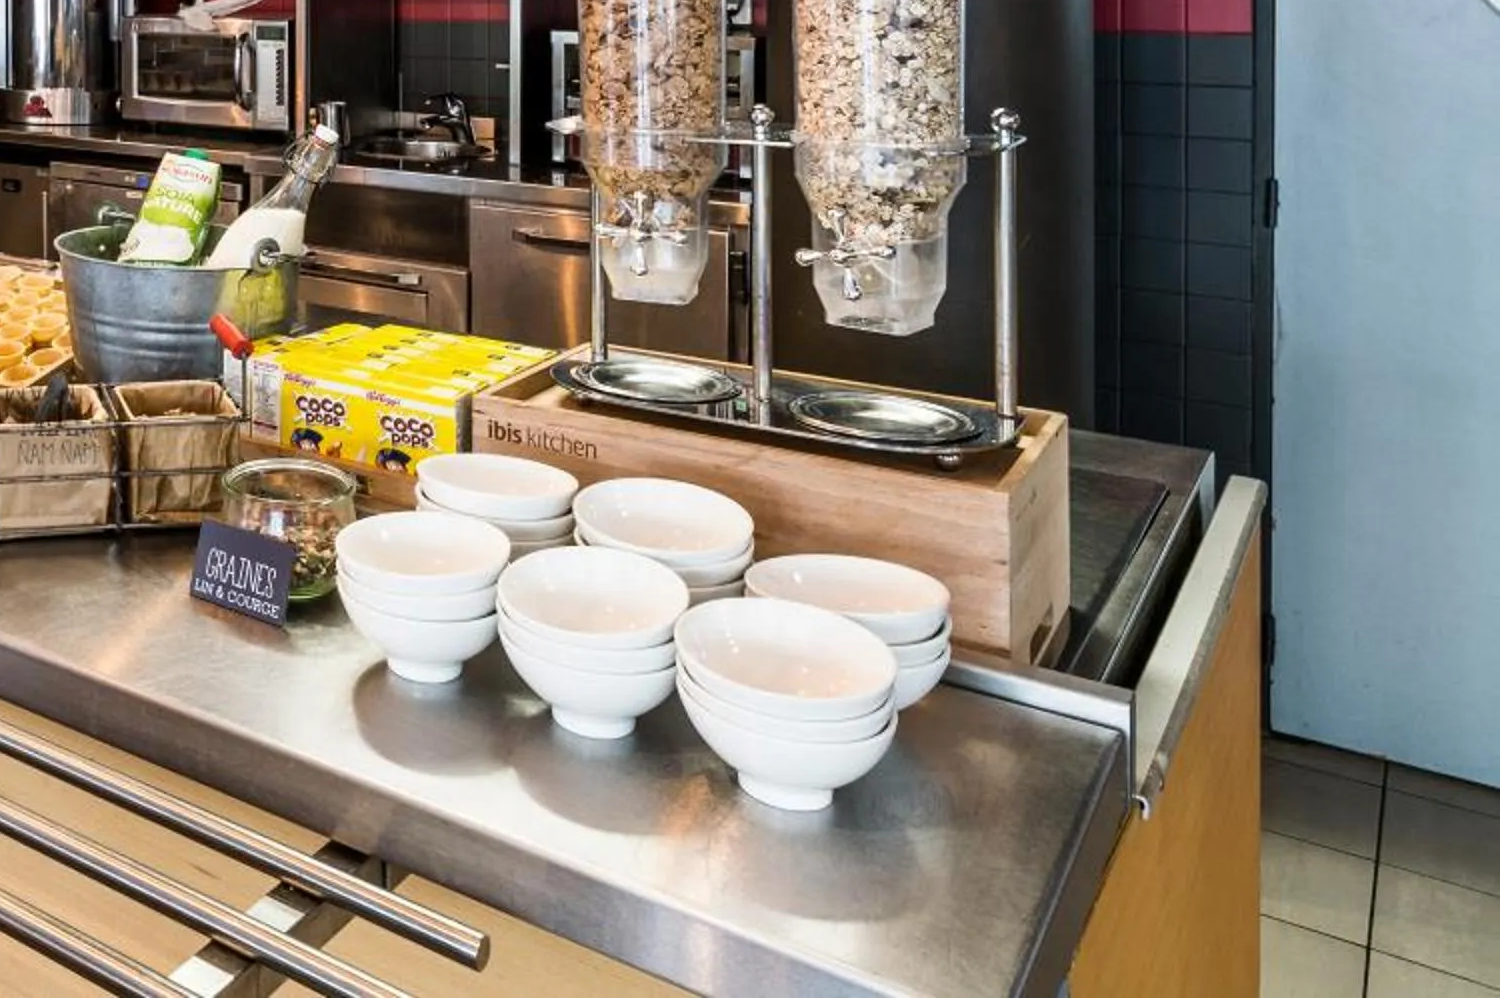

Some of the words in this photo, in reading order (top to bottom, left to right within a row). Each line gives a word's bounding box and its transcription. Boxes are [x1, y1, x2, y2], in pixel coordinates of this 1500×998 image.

[155, 186, 195, 206] SOJA
[487, 419, 522, 444] ibis
[526, 425, 598, 459] kitchen
[205, 547, 277, 599] GRAINES
[194, 577, 215, 596] LIN
[214, 585, 225, 599] &
[227, 590, 281, 619] COURGE
